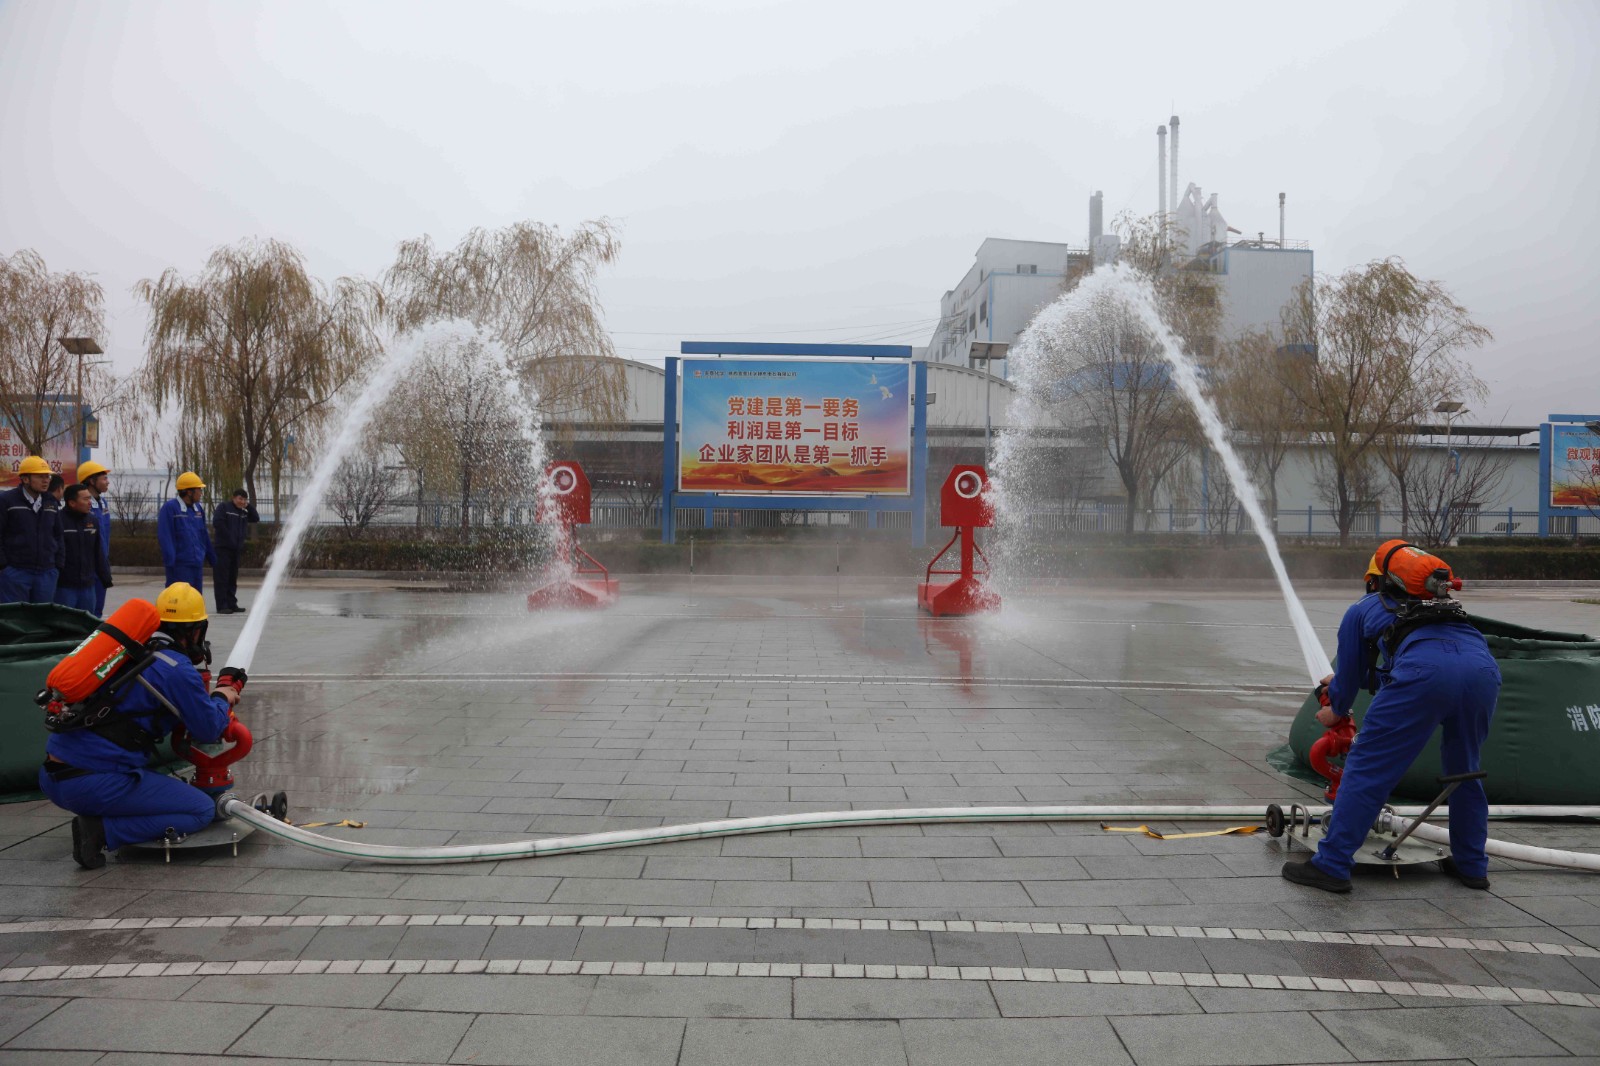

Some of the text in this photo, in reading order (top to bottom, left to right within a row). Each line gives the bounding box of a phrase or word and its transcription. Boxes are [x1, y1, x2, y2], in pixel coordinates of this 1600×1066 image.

[727, 396, 859, 418] 党建是第一要务
[727, 420, 859, 441] 利润是第一目标
[698, 443, 887, 466] 企业家团队是第一抓手
